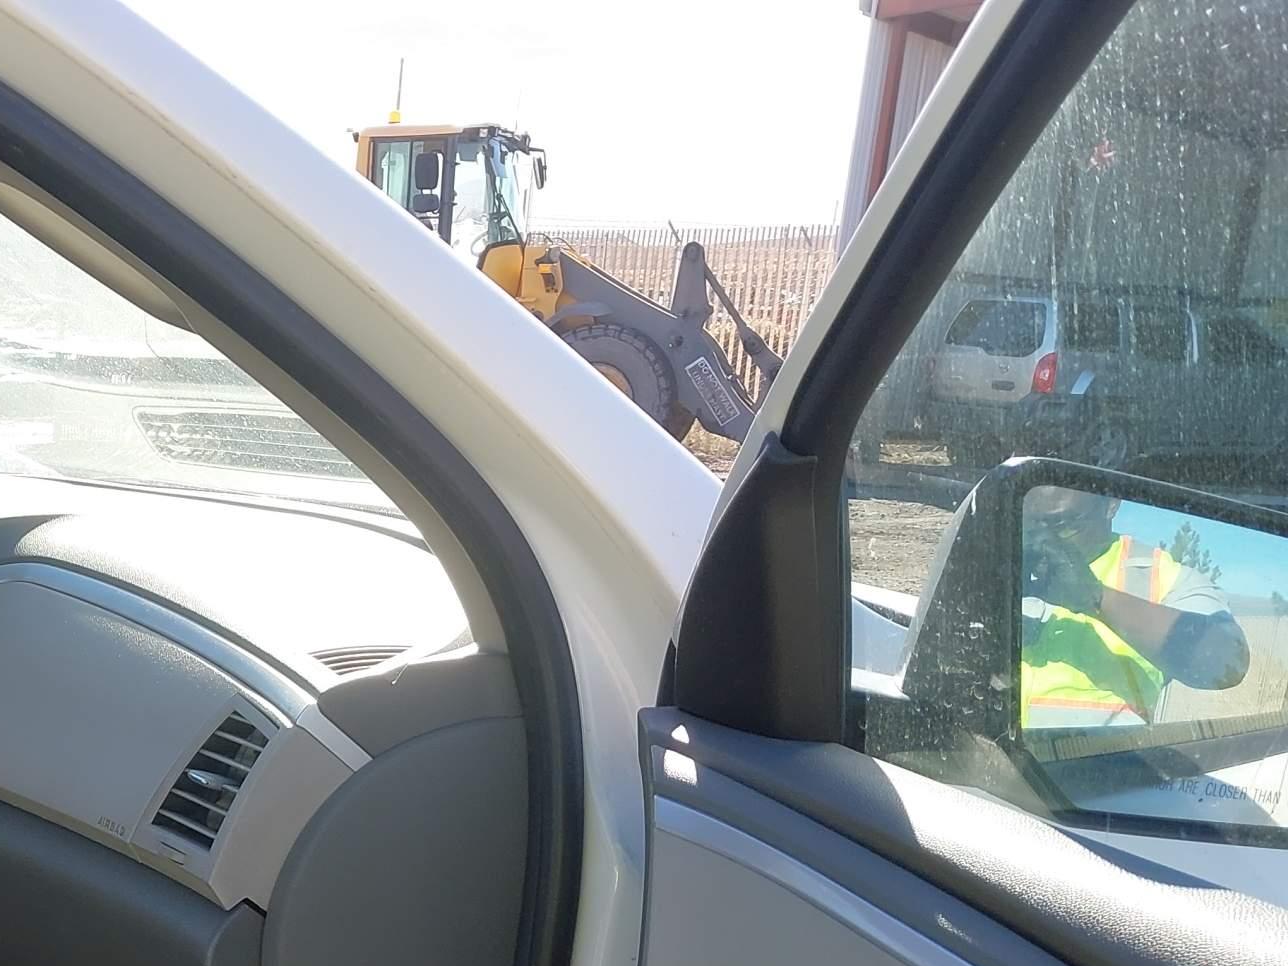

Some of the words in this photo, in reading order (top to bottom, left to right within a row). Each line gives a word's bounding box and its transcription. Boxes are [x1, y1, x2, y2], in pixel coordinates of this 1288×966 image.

[1178, 779, 1200, 796] ARE
[1205, 781, 1249, 801] CLOSER
[1253, 787, 1283, 805] THAN
